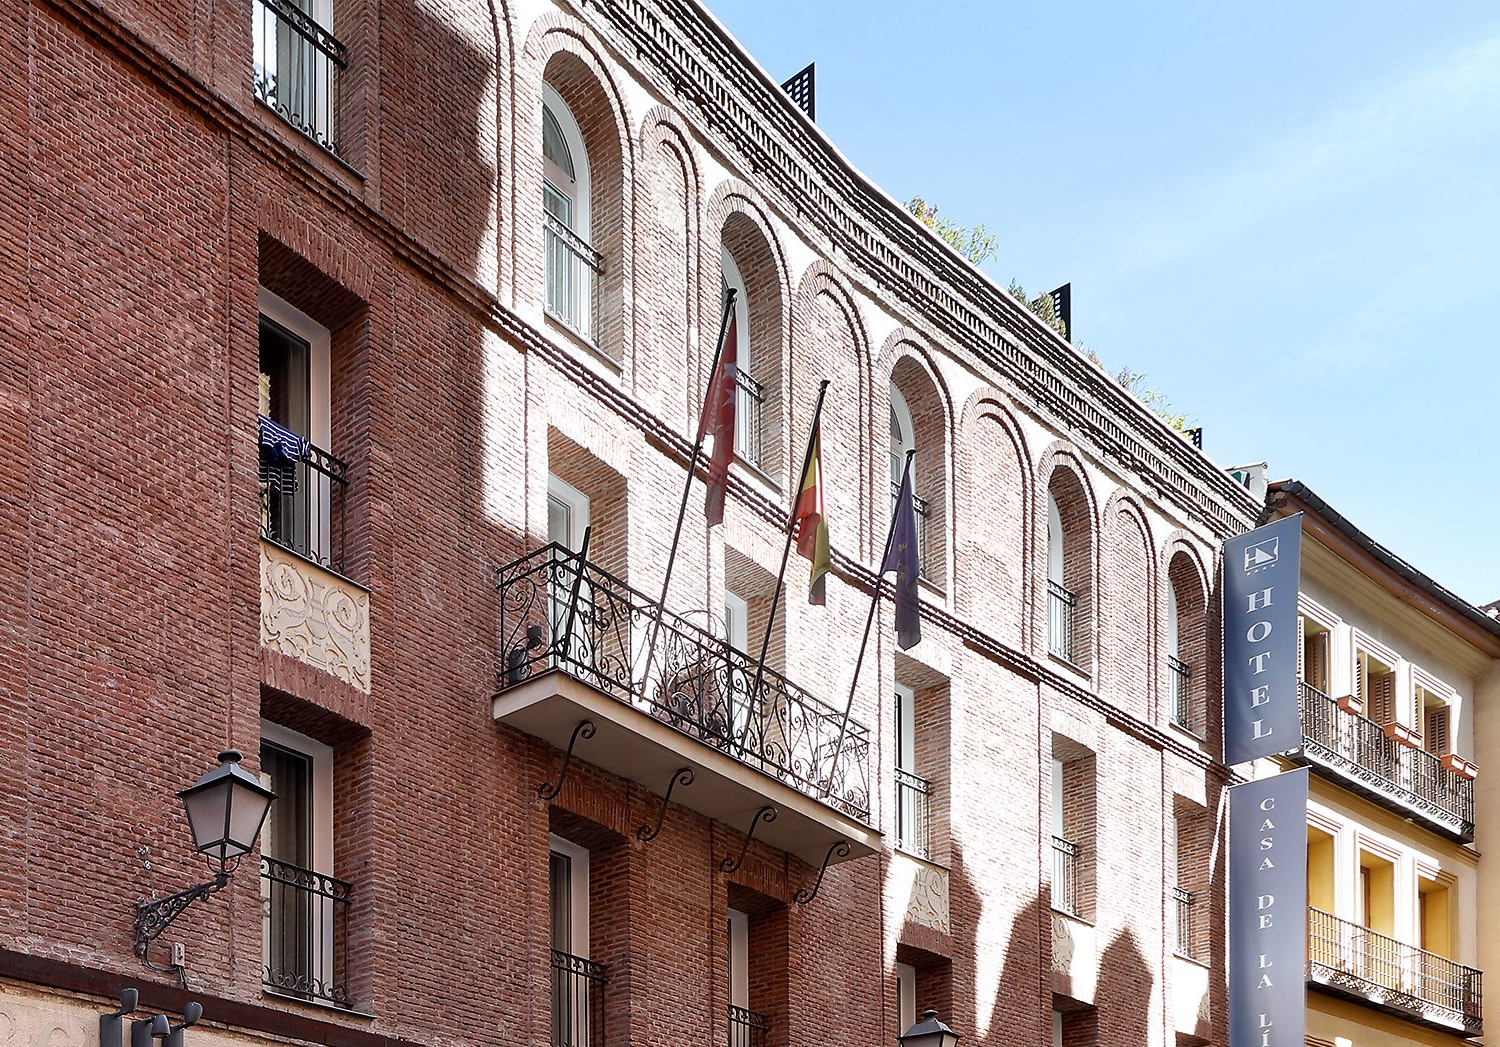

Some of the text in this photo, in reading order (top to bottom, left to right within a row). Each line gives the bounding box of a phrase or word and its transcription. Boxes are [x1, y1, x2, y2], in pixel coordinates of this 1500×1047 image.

[1246, 586, 1275, 742] HOTEL
[1258, 797, 1276, 872] CASA
[1257, 893, 1275, 930] DE
[1257, 953, 1274, 991] LA
